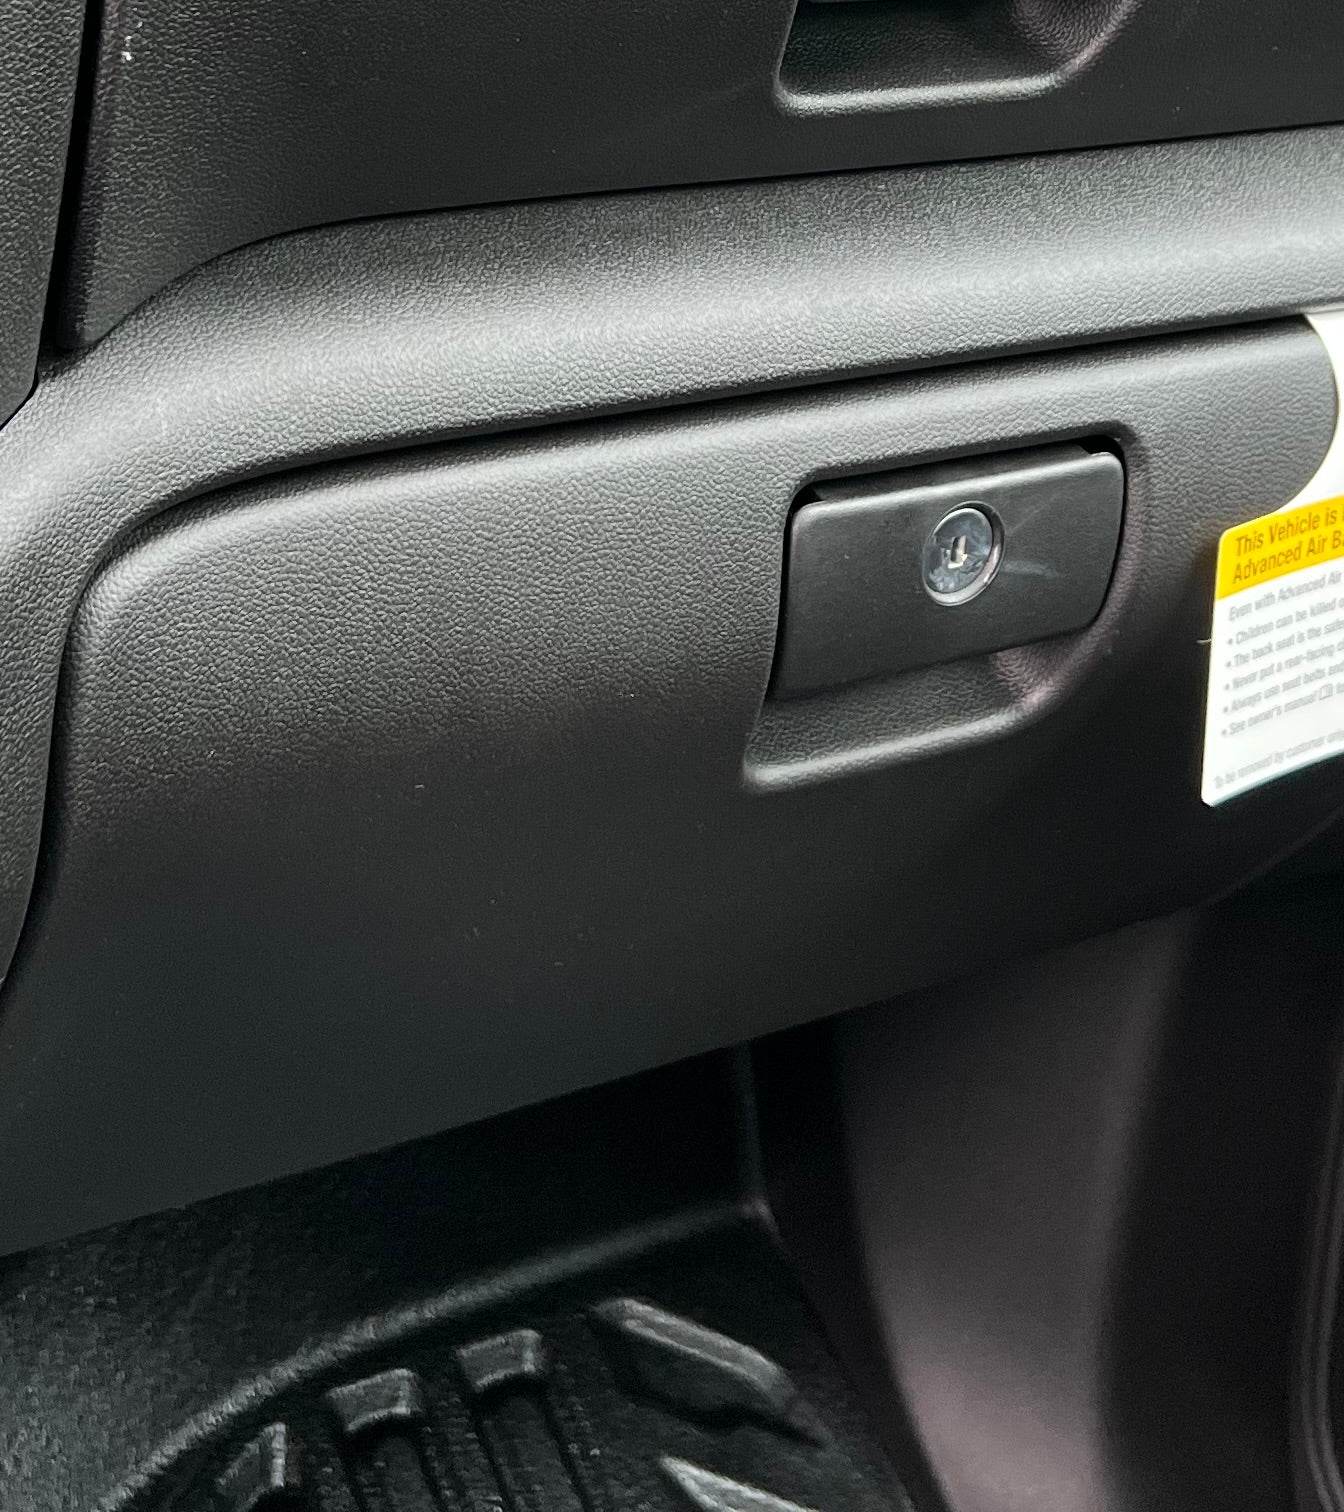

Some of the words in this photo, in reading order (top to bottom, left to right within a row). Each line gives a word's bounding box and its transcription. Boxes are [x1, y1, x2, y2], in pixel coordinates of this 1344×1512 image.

[1236, 530, 1264, 557] This
[1269, 512, 1320, 544] Vehicle
[1325, 507, 1337, 526] is
[1232, 540, 1302, 584] Advanced
[1306, 534, 1327, 557] Air
